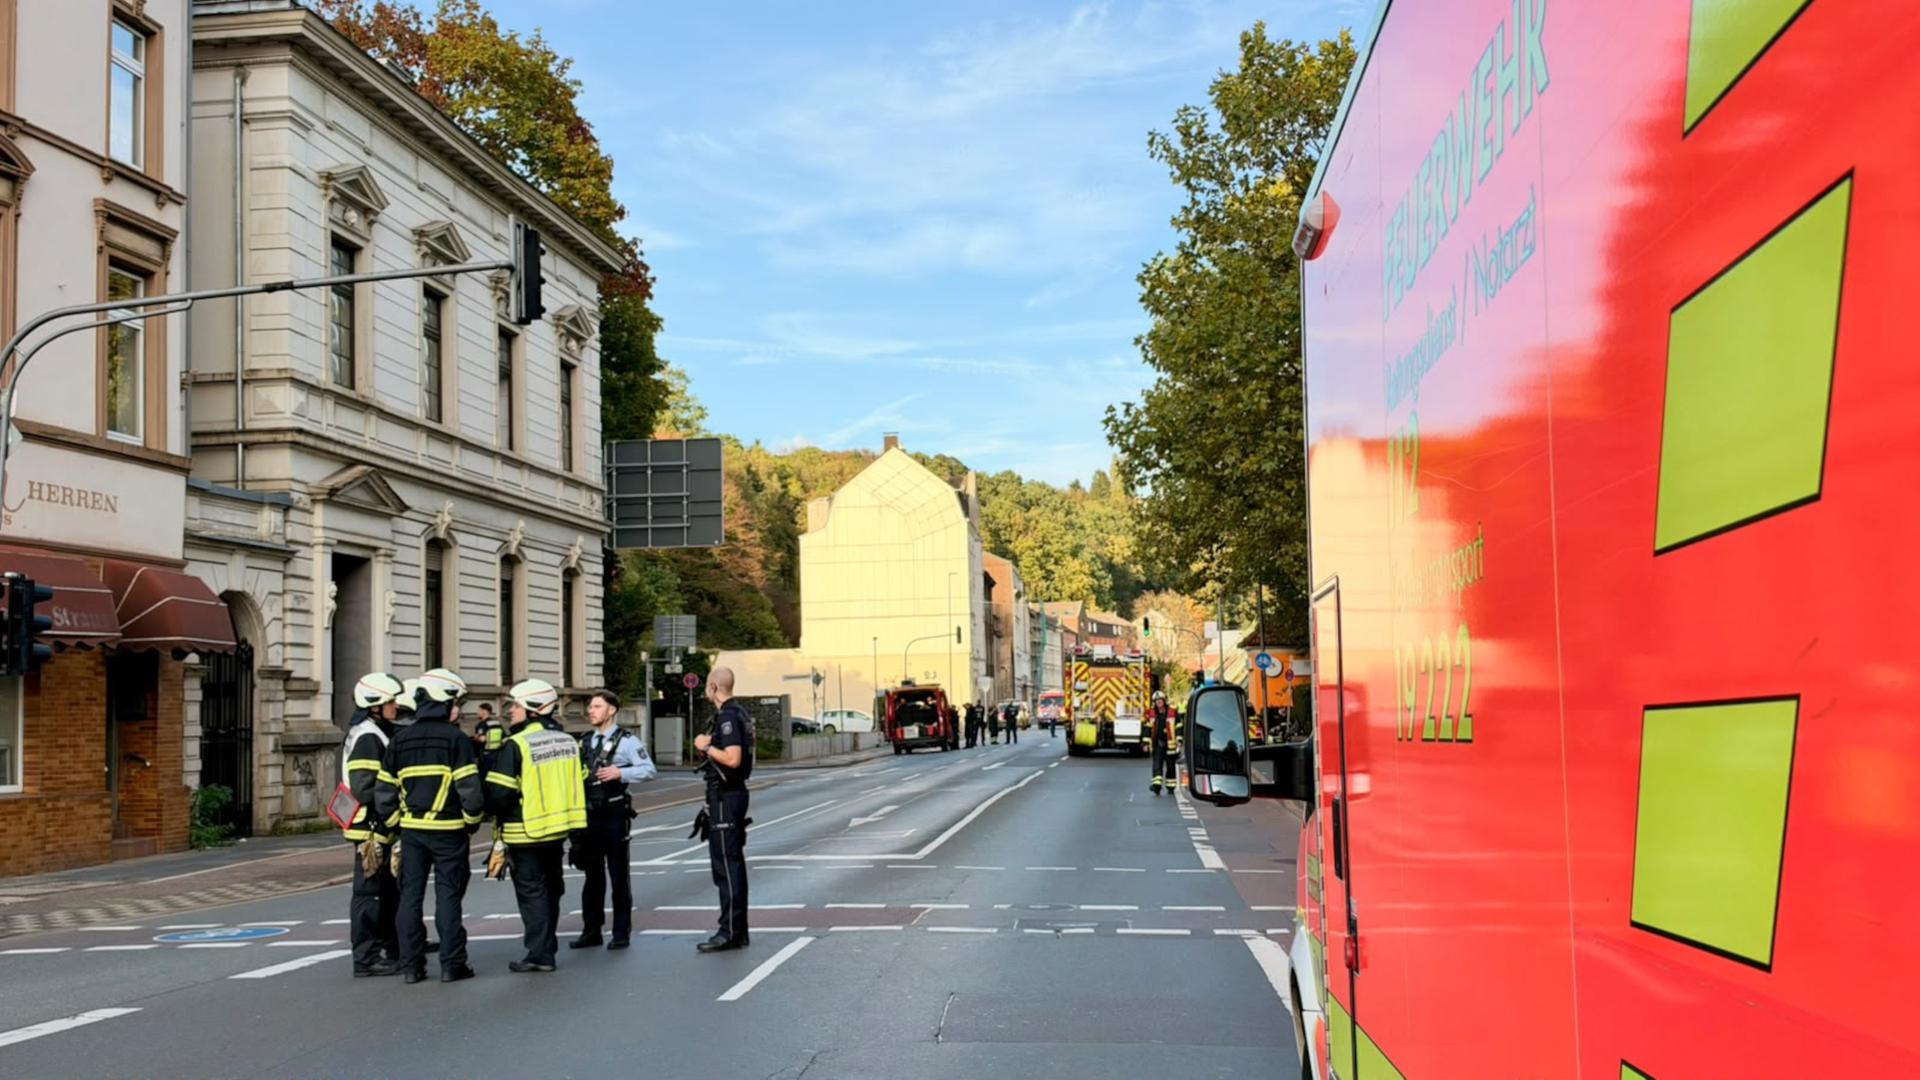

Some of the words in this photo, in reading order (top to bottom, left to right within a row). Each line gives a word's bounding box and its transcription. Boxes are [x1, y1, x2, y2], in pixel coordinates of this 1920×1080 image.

[1383, 0, 1551, 323] FEUERWEHR
[1473, 183, 1537, 317] Notarzt
[27, 480, 119, 513] HERREN
[1386, 409, 1420, 529] 112
